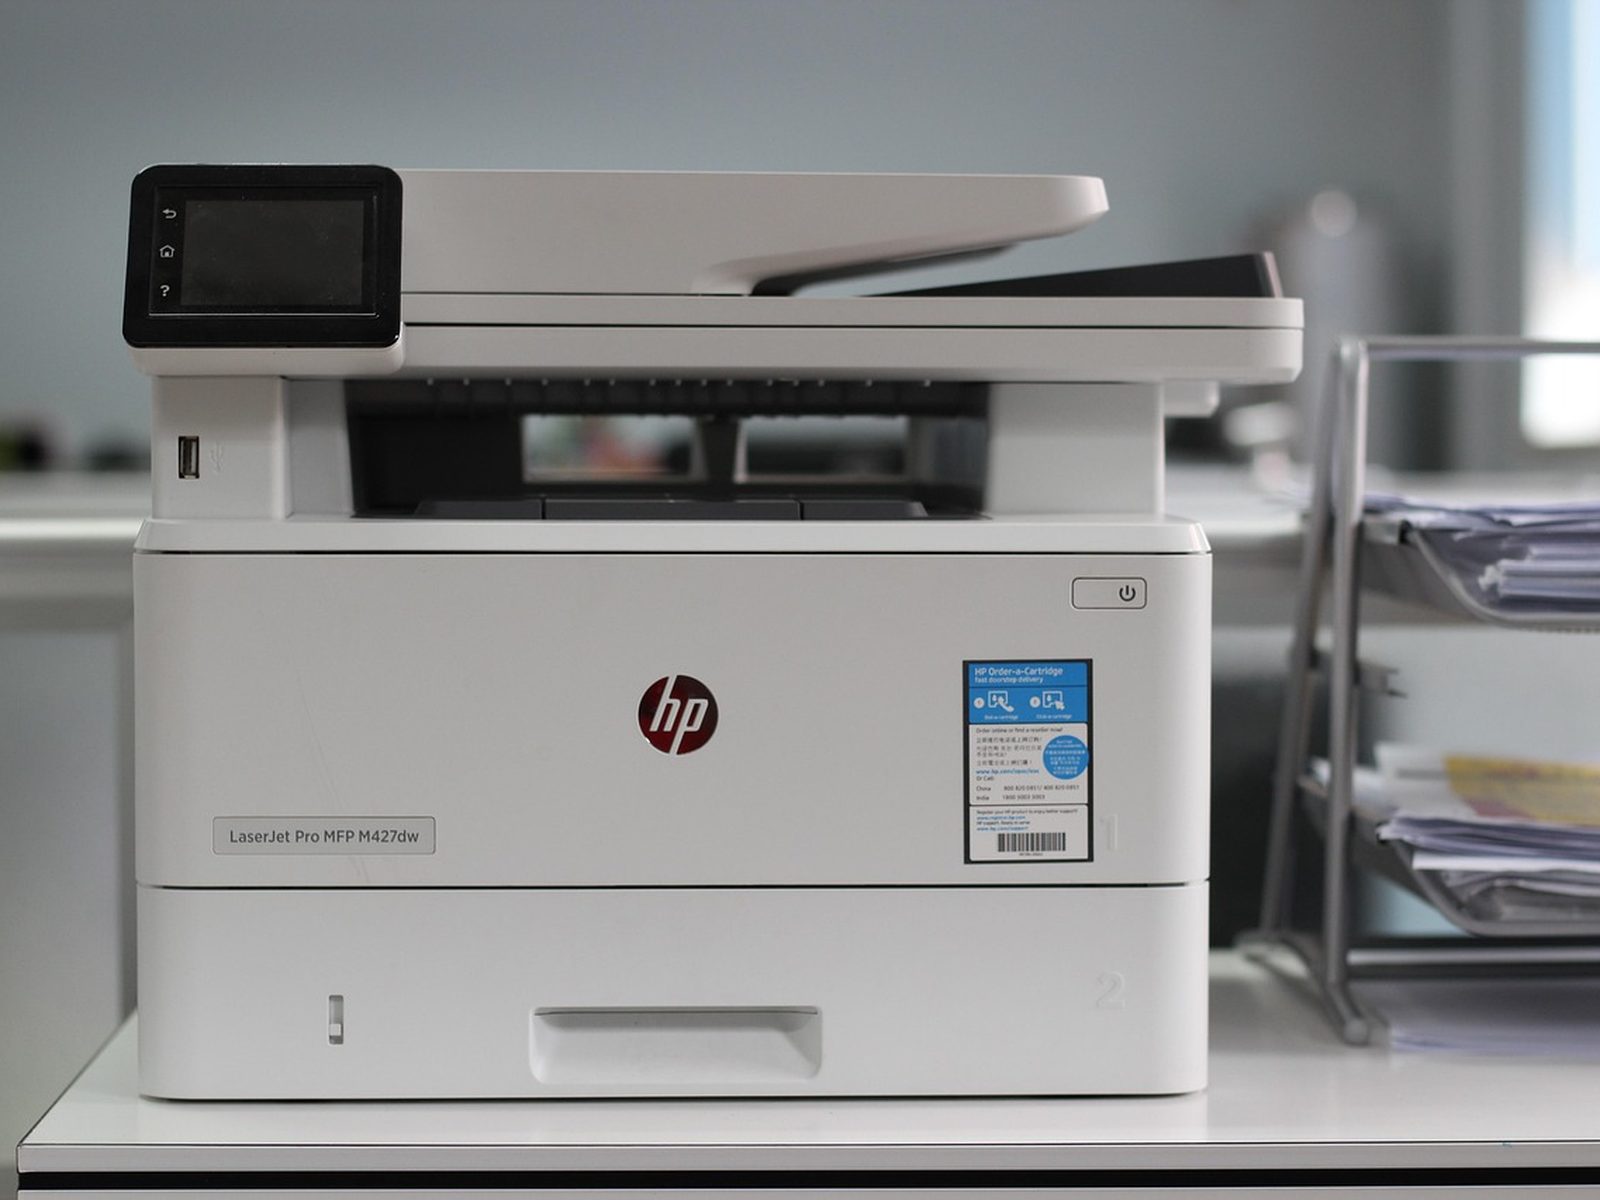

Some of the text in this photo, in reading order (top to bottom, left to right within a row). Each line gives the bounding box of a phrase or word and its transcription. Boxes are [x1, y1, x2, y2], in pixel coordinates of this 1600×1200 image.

[974, 666, 1063, 676] HP Order-a-Cartridge
[988, 676, 1016, 684] doorstep
[1017, 676, 1043, 684] delivery
[649, 675, 709, 755] hp
[229, 829, 419, 843] LaserJet Pro MFP M427dw
[1096, 970, 1126, 1009] 2
